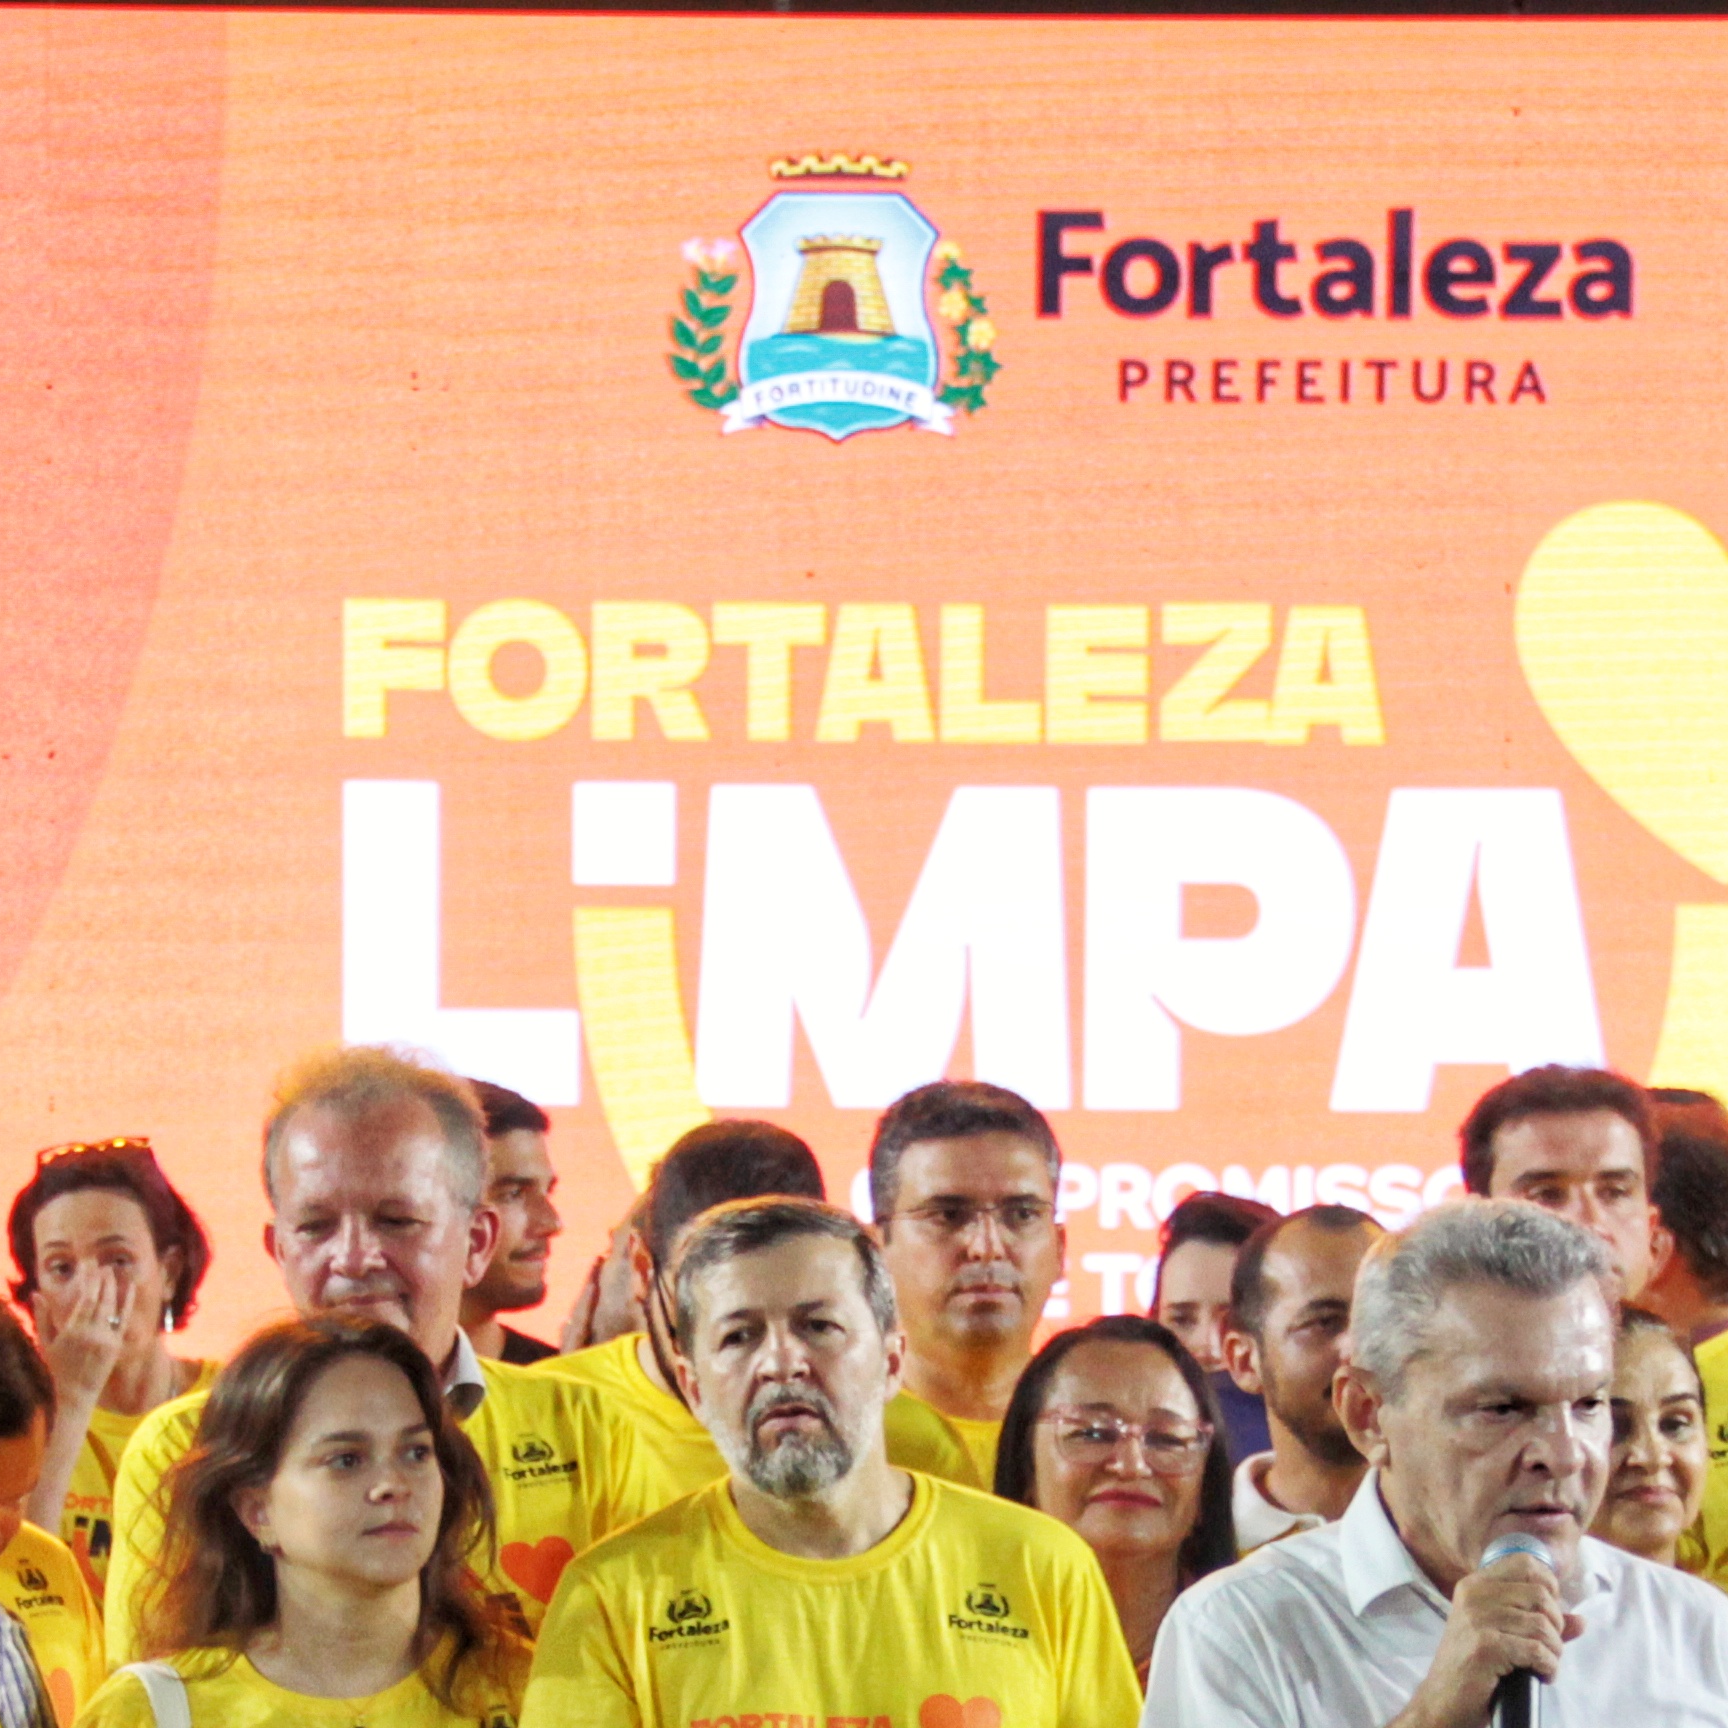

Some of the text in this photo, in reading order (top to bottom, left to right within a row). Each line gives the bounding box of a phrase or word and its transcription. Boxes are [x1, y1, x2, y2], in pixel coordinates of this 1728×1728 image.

[1036, 207, 1636, 320] Fortaleza
[753, 376, 919, 408] FORTITUDINE
[1119, 359, 1549, 404] PREFEITURA
[342, 597, 1385, 746] FORTALEZA
[648, 1617, 730, 1642] Fortaleza
[948, 1612, 1030, 1640] Fortaleza
